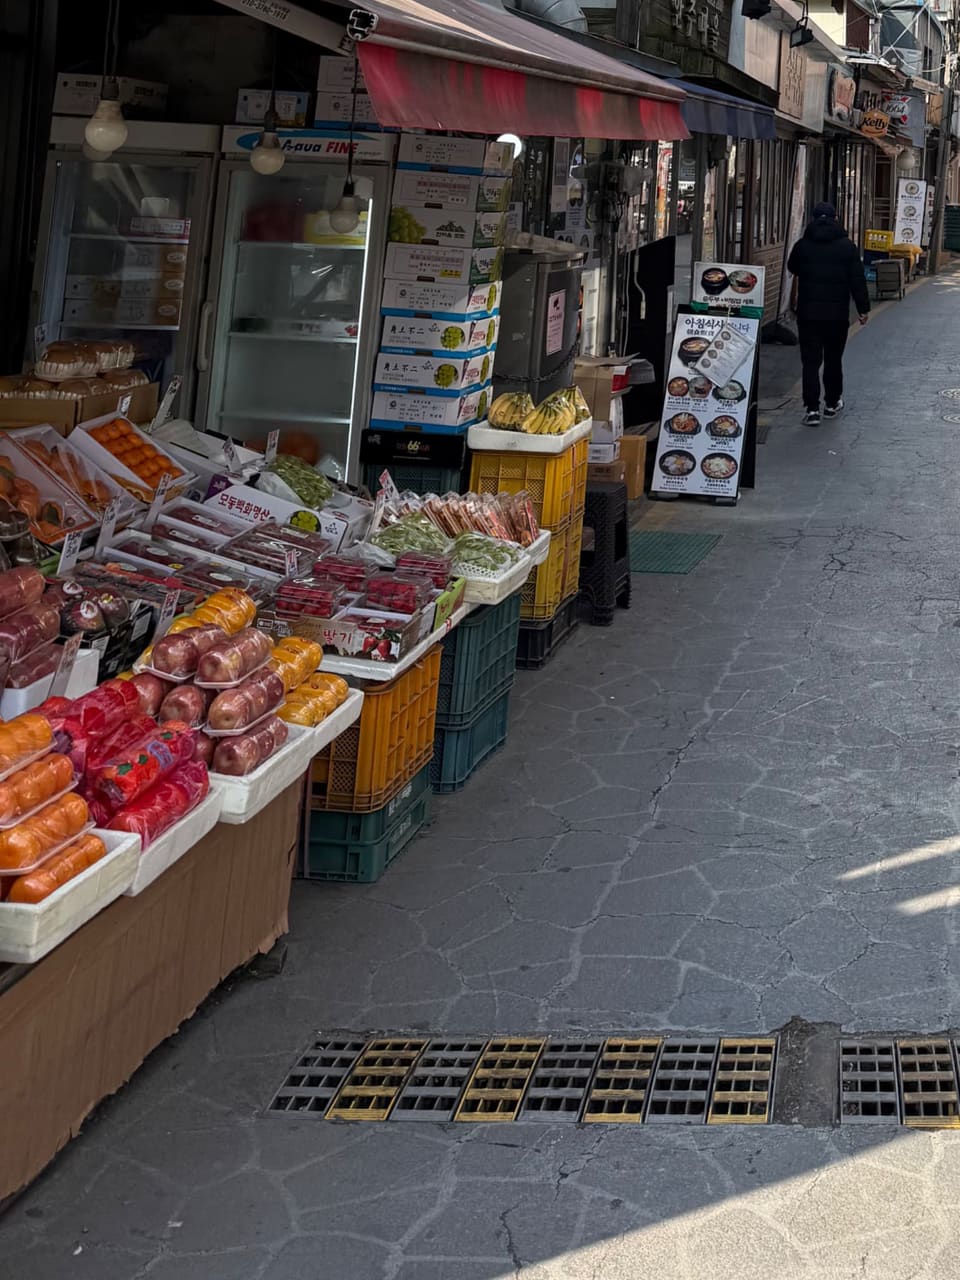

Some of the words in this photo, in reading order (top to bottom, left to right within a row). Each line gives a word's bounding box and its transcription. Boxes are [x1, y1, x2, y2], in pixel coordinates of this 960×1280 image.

[863, 117, 887, 130] Kelly
[325, 141, 360, 154] FINE
[685, 318, 725, 330] 아침식사
[218, 492, 271, 522] 모동백화명산
